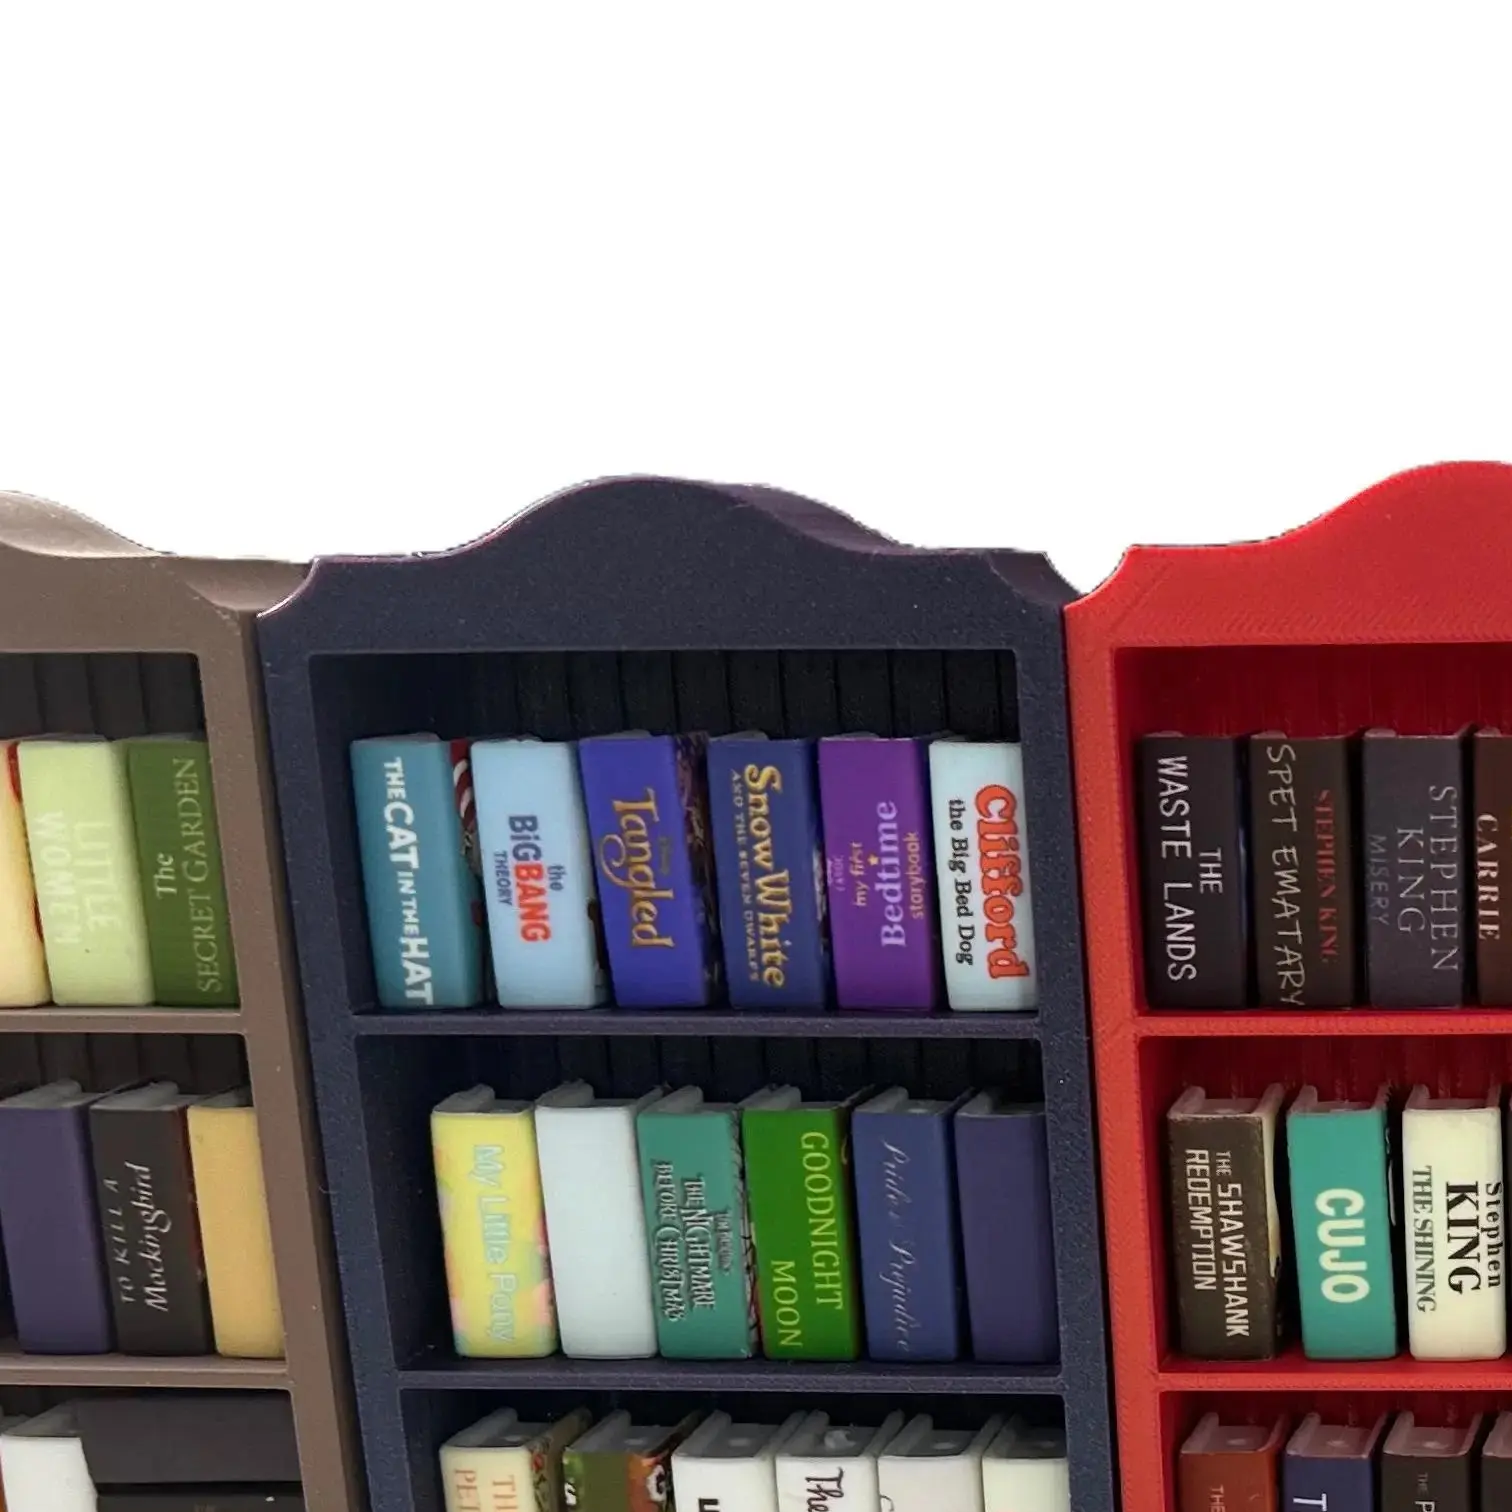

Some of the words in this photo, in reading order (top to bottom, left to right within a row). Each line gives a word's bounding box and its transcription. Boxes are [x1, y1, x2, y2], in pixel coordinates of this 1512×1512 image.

[173, 758, 210, 884] GARDEN
[383, 757, 406, 800] THE
[744, 764, 782, 871] Snow
[1157, 756, 1192, 859] WASTE
[34, 811, 81, 943] WOMEN
[73, 820, 121, 932] LITTLE
[156, 853, 177, 899] The
[383, 800, 419, 868] CAT
[493, 851, 513, 906] THEORY
[547, 865, 564, 892] the
[601, 788, 675, 948] Tangled
[874, 800, 906, 946] Bedtime
[903, 831, 926, 919] storybook
[974, 784, 1030, 979] Clifford
[1199, 847, 1223, 895] THE
[1314, 789, 1337, 899] STEPHEN
[1367, 834, 1390, 926] MISERY
[1397, 827, 1425, 934] KING
[1428, 785, 1459, 971] STEPHEN
[1476, 813, 1500, 941] CARRIE
[396, 871, 417, 897] IN
[400, 897, 420, 937] THE
[755, 869, 792, 987] White
[852, 881, 870, 906] my
[191, 890, 222, 994] SECRET
[400, 936, 434, 1006] HAT
[1163, 882, 1197, 982] LANDS
[103, 1178, 119, 1192] A
[467, 1144, 505, 1187] My
[654, 1162, 678, 1221] BEFORE
[683, 1175, 706, 1207] THE
[1215, 1150, 1232, 1177] THE
[1412, 1165, 1433, 1217] THE
[107, 1208, 132, 1264] KILL
[124, 1160, 173, 1312] Mockingbird
[478, 1195, 512, 1265] Little
[679, 1207, 717, 1310] NIGHTMARE
[800, 1131, 844, 1311] GOODNIGHT
[1185, 1149, 1217, 1291] REDEMPTION
[1216, 1183, 1250, 1337] SHAWSHANK
[1315, 1188, 1371, 1304] CUJO
[1412, 1217, 1437, 1313] SHINING
[1445, 1181, 1482, 1295] KING
[1481, 1181, 1504, 1289] Stephen
[117, 1276, 136, 1303] TO
[485, 1272, 519, 1344] Pony
[654, 1227, 686, 1322] CHRISTMAS
[770, 1259, 804, 1348] MOON
[1417, 1472, 1429, 1493] THE
